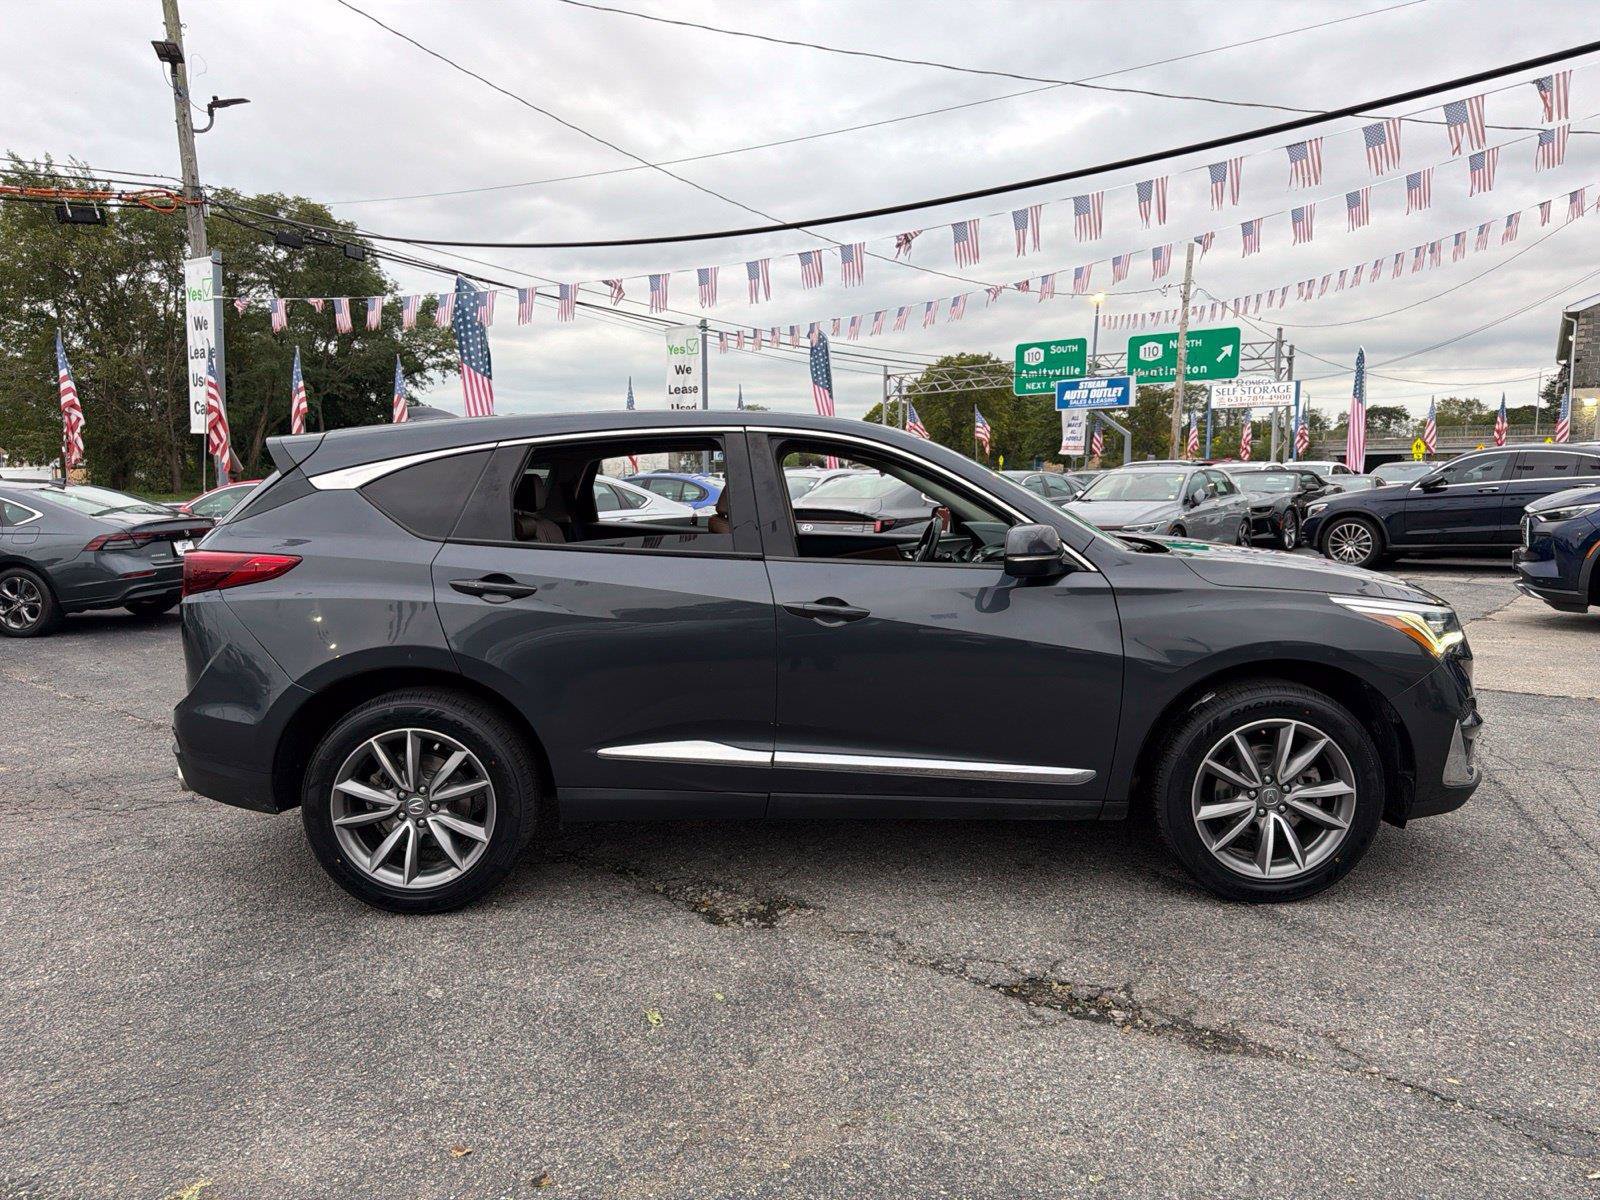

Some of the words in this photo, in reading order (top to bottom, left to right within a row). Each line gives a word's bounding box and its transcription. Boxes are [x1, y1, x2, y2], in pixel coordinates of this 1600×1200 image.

[187, 287, 202, 301] Yes
[194, 316, 208, 331] We
[190, 345, 215, 359] Leae
[668, 345, 685, 355] Yes
[1027, 351, 1041, 362] 110
[1050, 345, 1078, 354] SOUTH
[1143, 346, 1159, 357] 110
[675, 364, 692, 375] We
[1020, 366, 1080, 378] Amityville
[1133, 365, 1207, 377] Huntinton
[668, 385, 698, 395] Lease
[1025, 382, 1046, 390] NEXT
[1079, 380, 1108, 389] STREAM
[1216, 387, 1236, 396] SELF
[1240, 384, 1292, 396] STORAGE
[1063, 389, 1089, 400] AUTO
[1089, 387, 1124, 398] OUTLET
